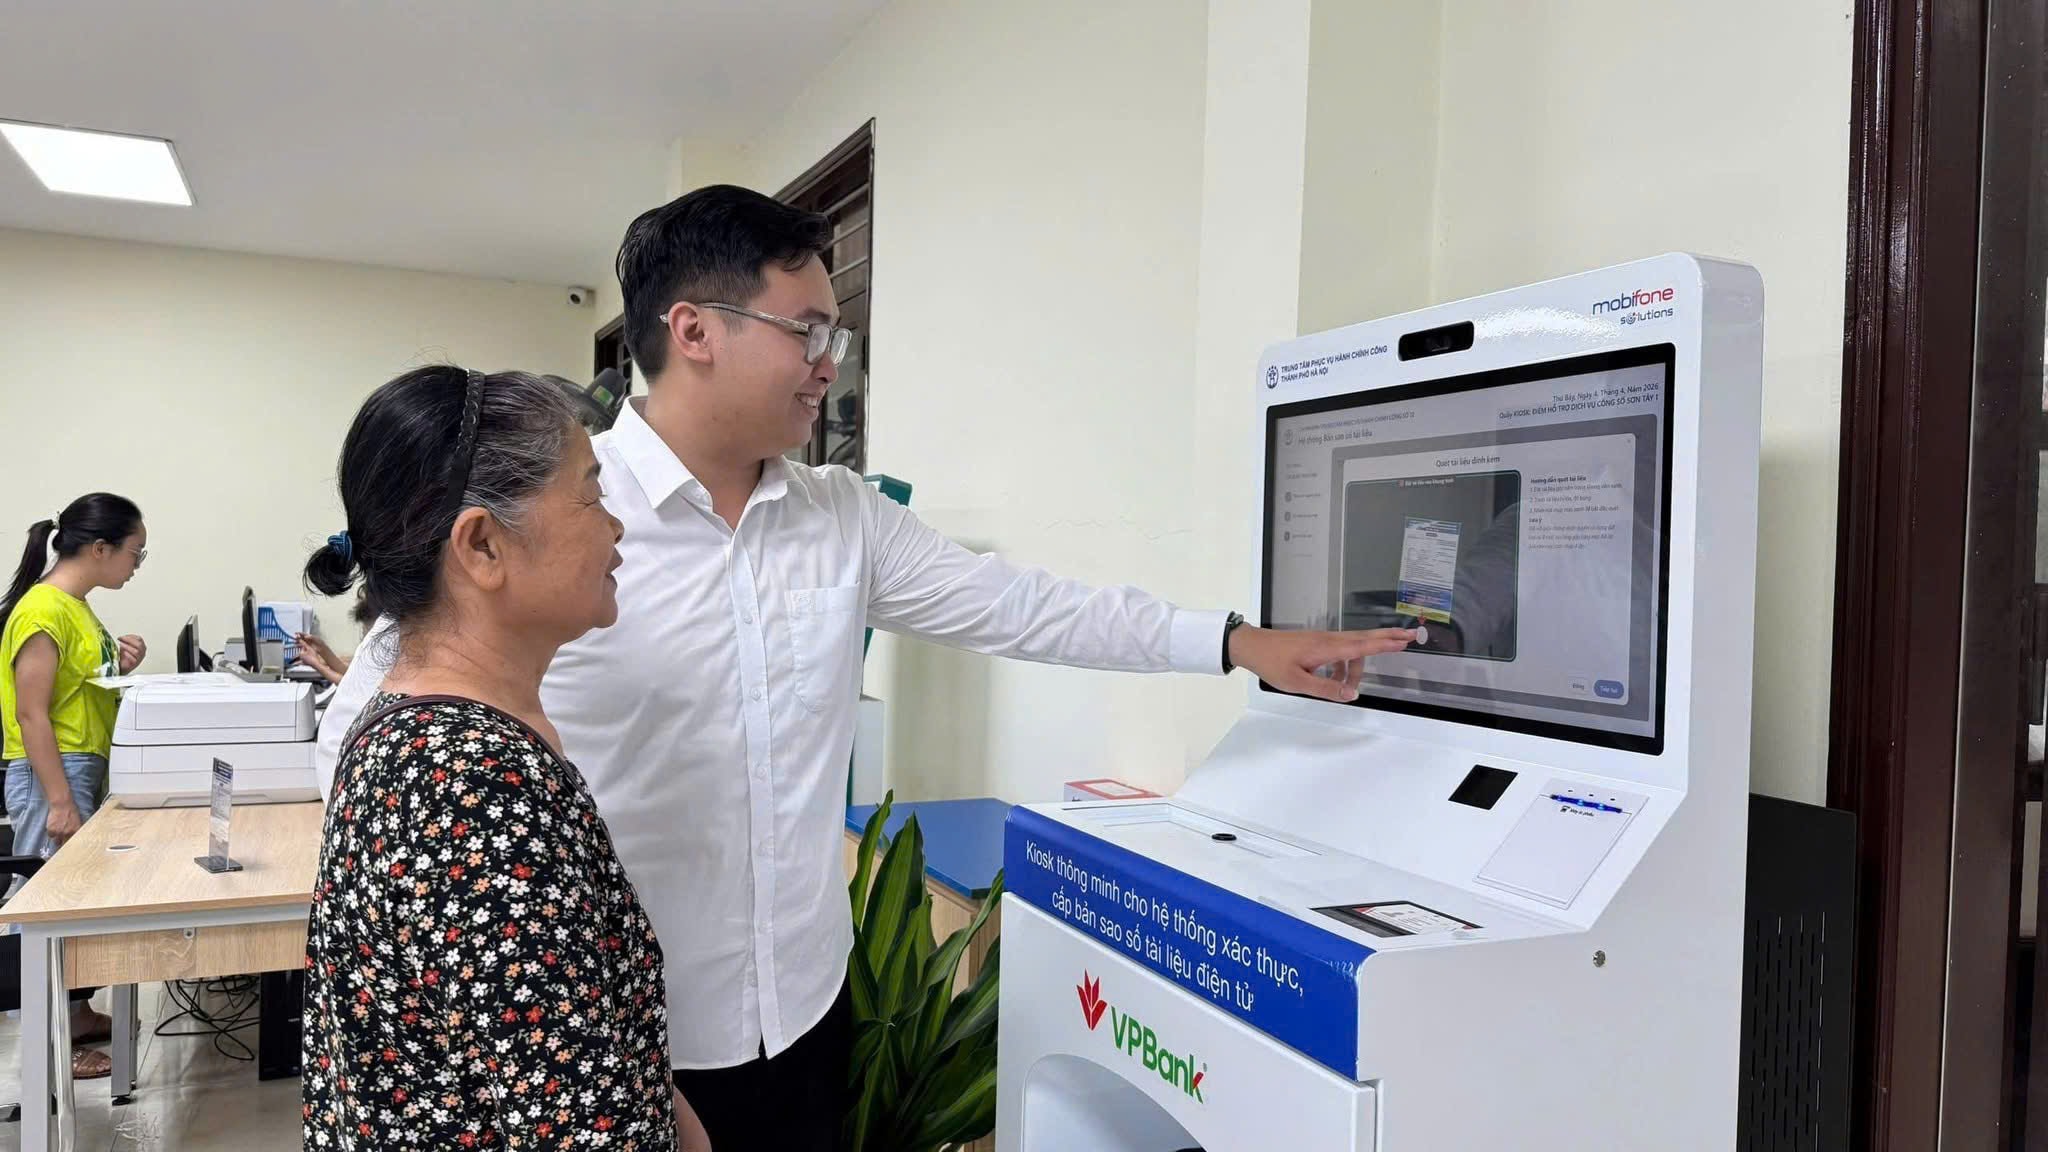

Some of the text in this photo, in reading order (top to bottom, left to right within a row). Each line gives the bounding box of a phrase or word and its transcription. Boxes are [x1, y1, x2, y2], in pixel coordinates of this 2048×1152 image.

[1593, 288, 1674, 315] mobifone
[1281, 364, 1298, 372] TRUNG
[1026, 840, 1303, 997] Kiosk thông minh cho hệ thống xác thực,
[1052, 886, 1254, 1011] cấp bản sao số tài liệu điện tử
[1111, 1005, 1204, 1104] VPBank
